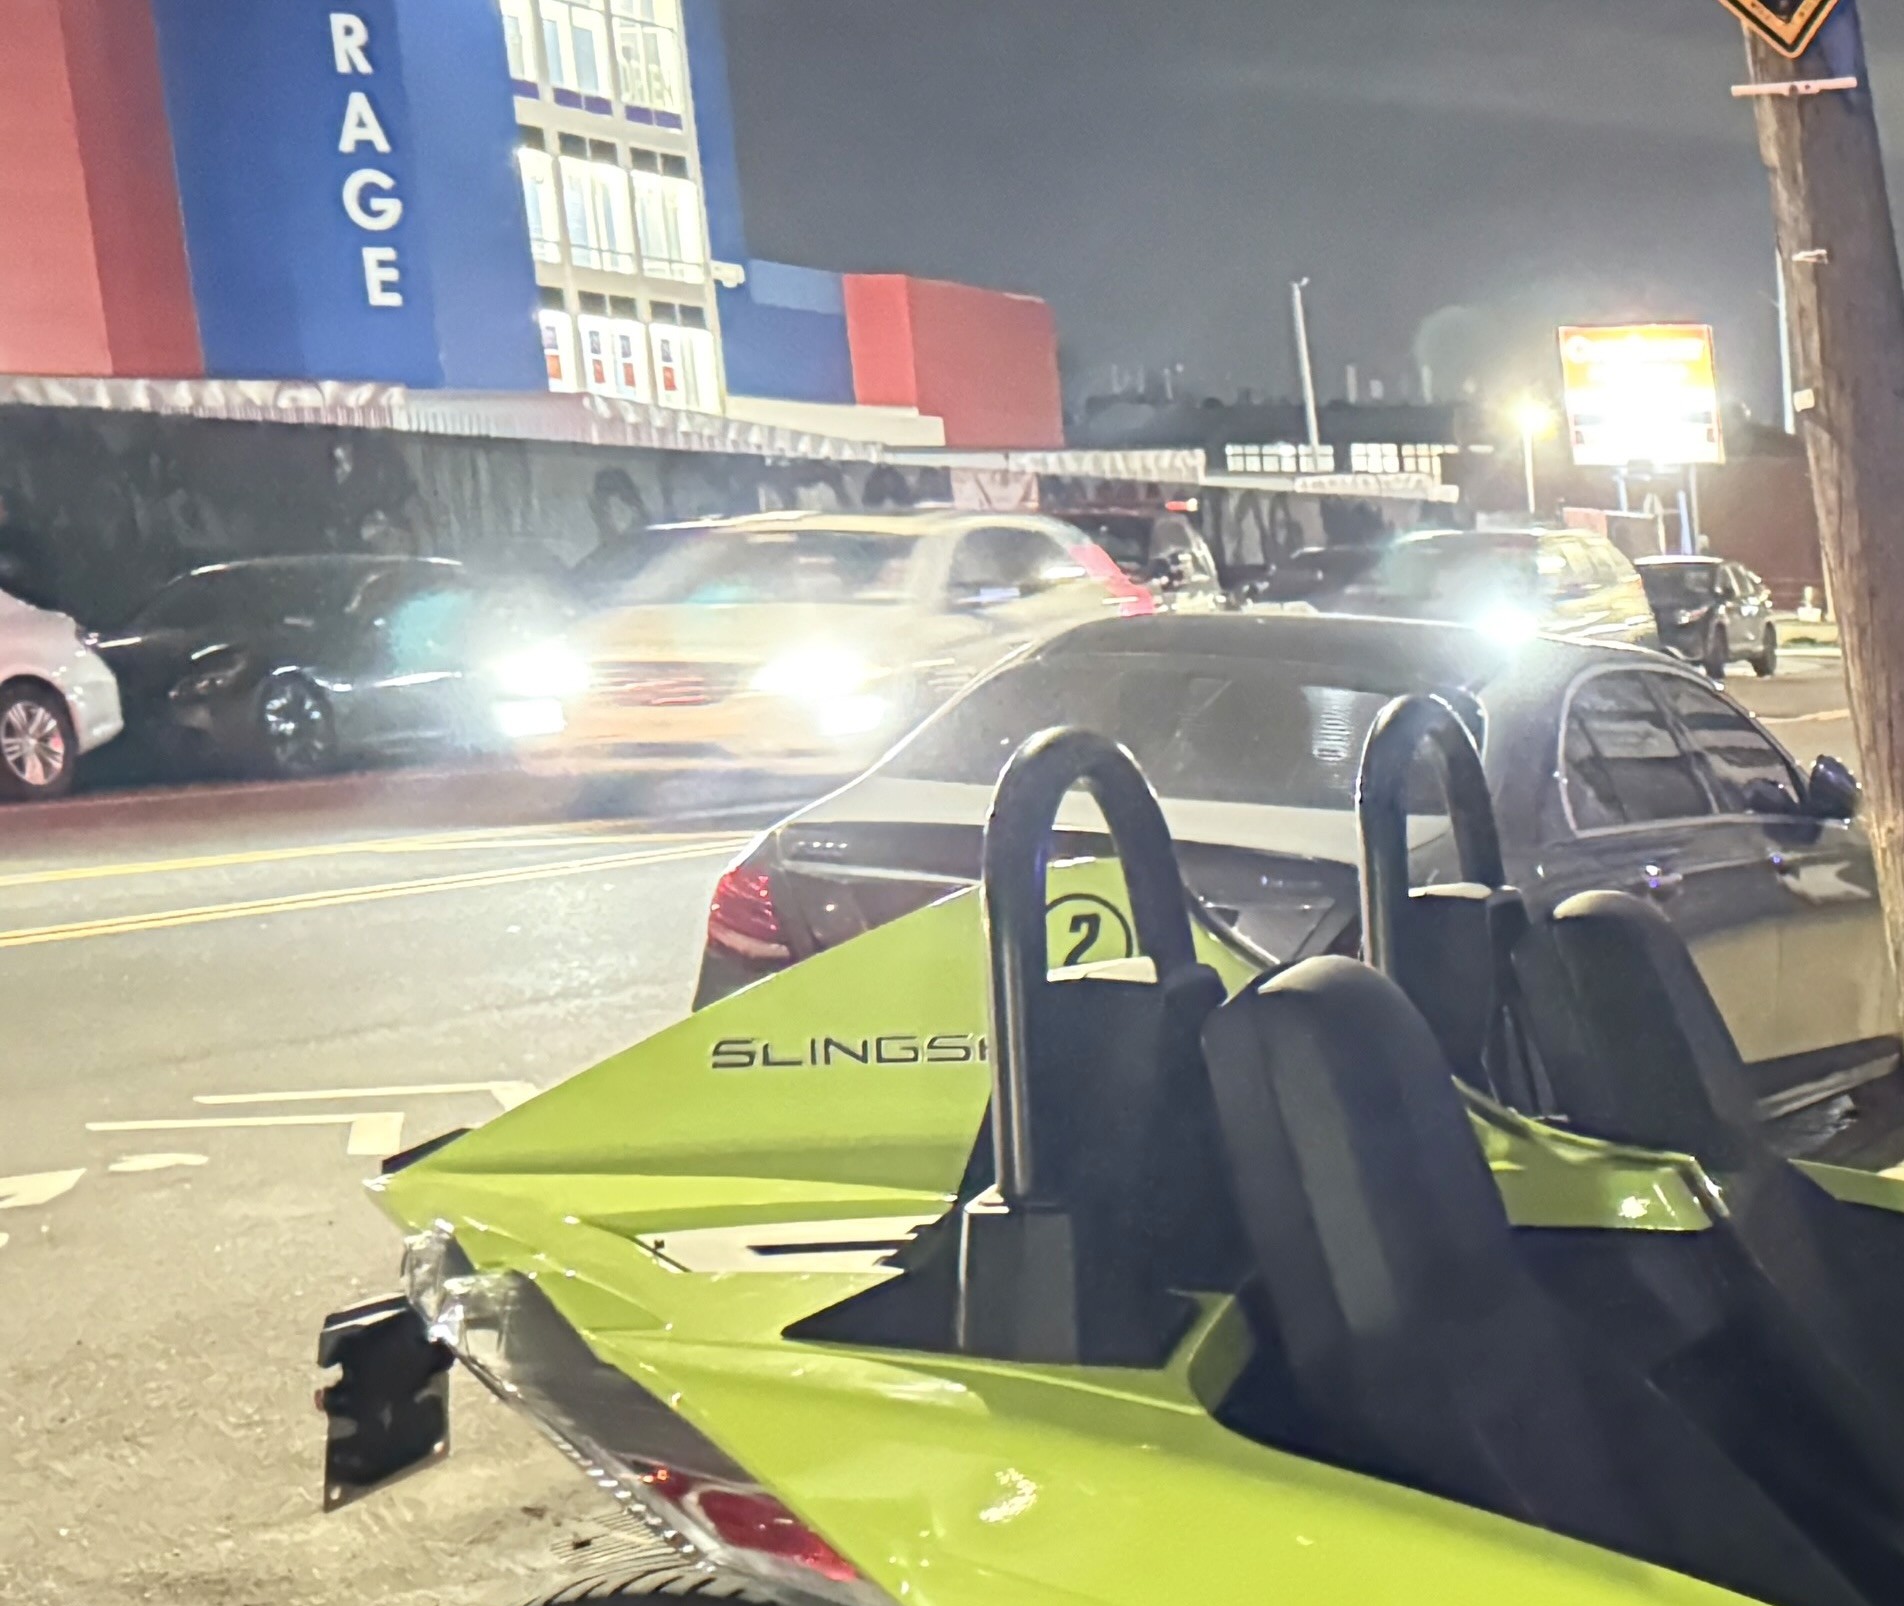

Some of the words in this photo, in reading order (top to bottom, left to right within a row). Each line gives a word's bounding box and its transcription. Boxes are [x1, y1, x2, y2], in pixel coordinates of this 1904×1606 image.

[330, 13, 403, 307] RAGE
[1063, 912, 1102, 967] 2
[712, 1034, 987, 1069] SLINGS
